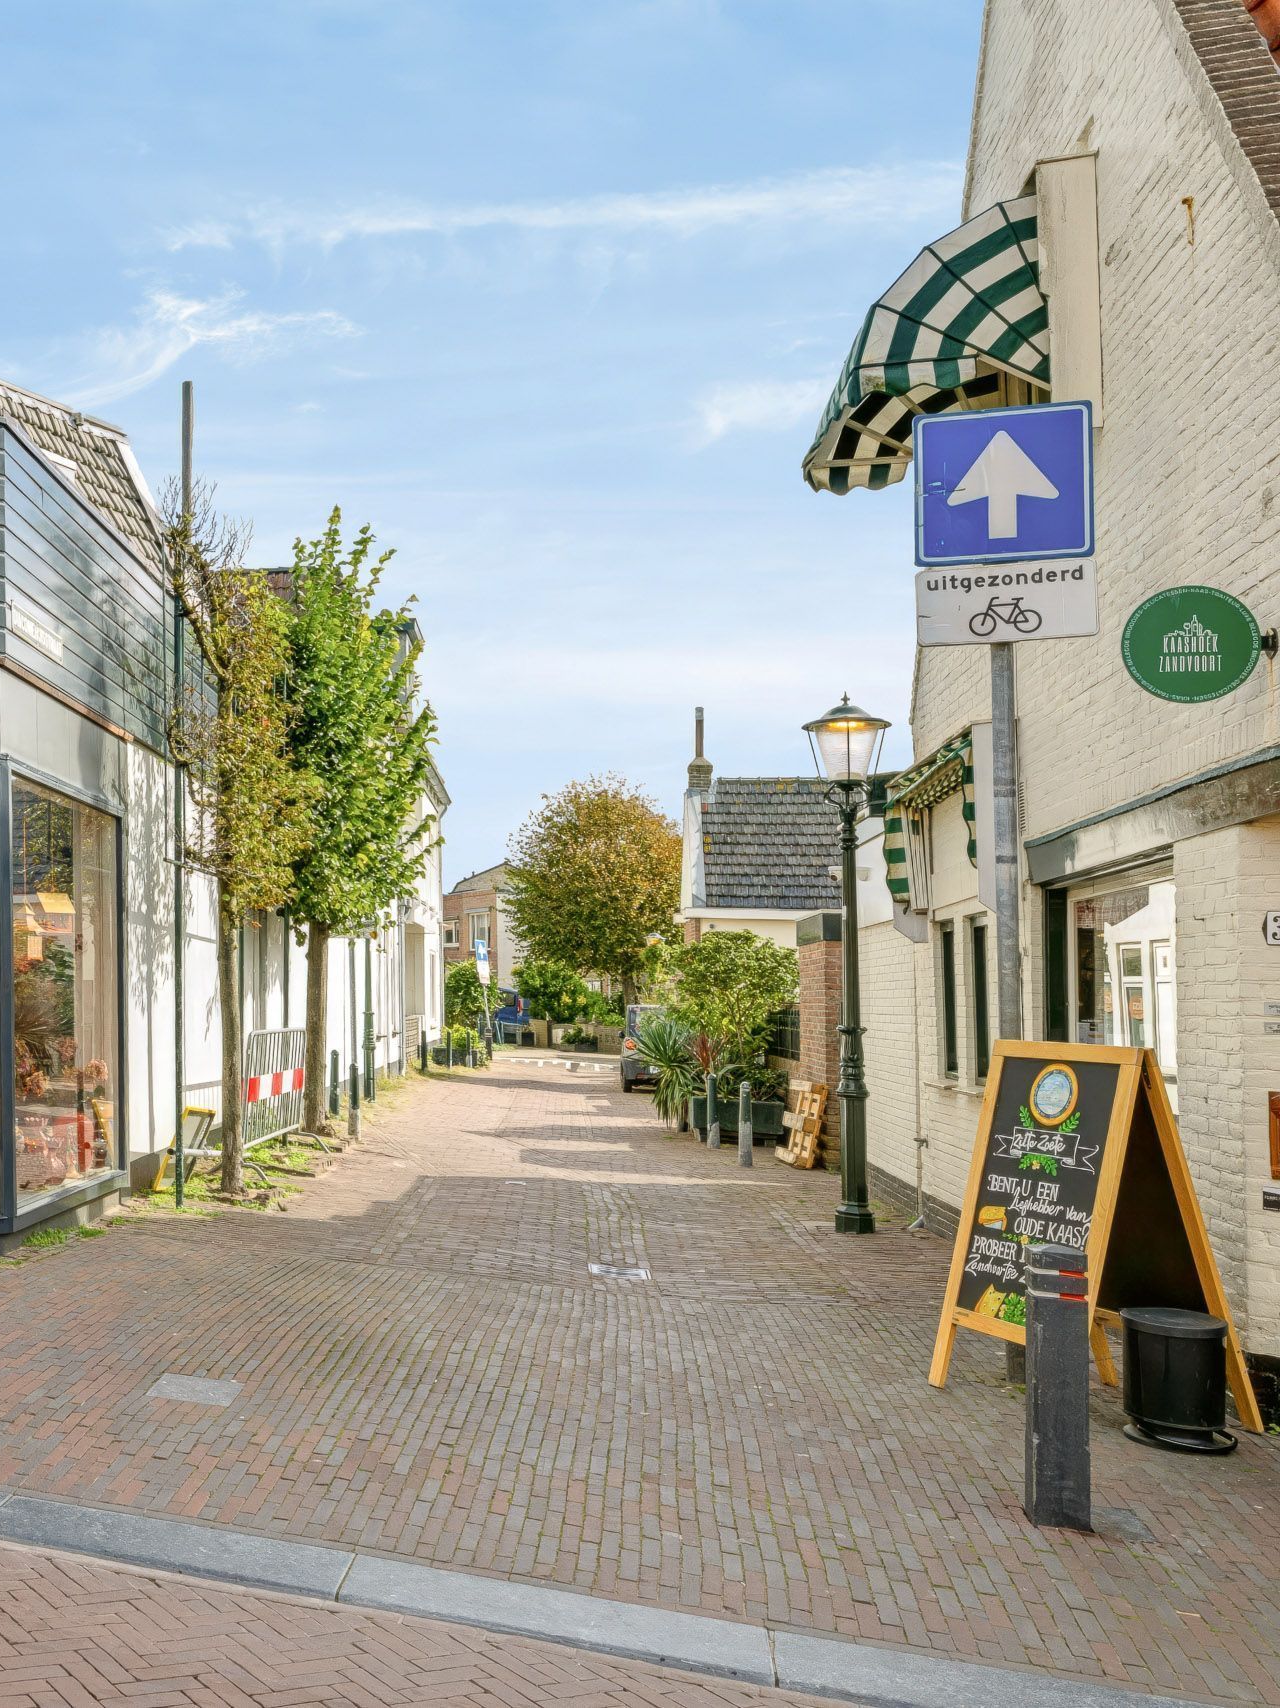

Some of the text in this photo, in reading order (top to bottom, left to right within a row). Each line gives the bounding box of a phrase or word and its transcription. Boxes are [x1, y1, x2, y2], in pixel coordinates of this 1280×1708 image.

[926, 564, 1083, 593] uitgezonderd
[1163, 635, 1218, 653] KAASHOEK
[1158, 654, 1222, 673] ZANDVOORT
[1036, 1133, 1066, 1156] Zoete
[987, 1174, 1060, 1202] BENT U EEN
[1007, 1186, 1065, 1216] Liefhebber
[1014, 1216, 1091, 1251] OUDE KAAS?
[971, 1235, 1018, 1261] PROBEER
